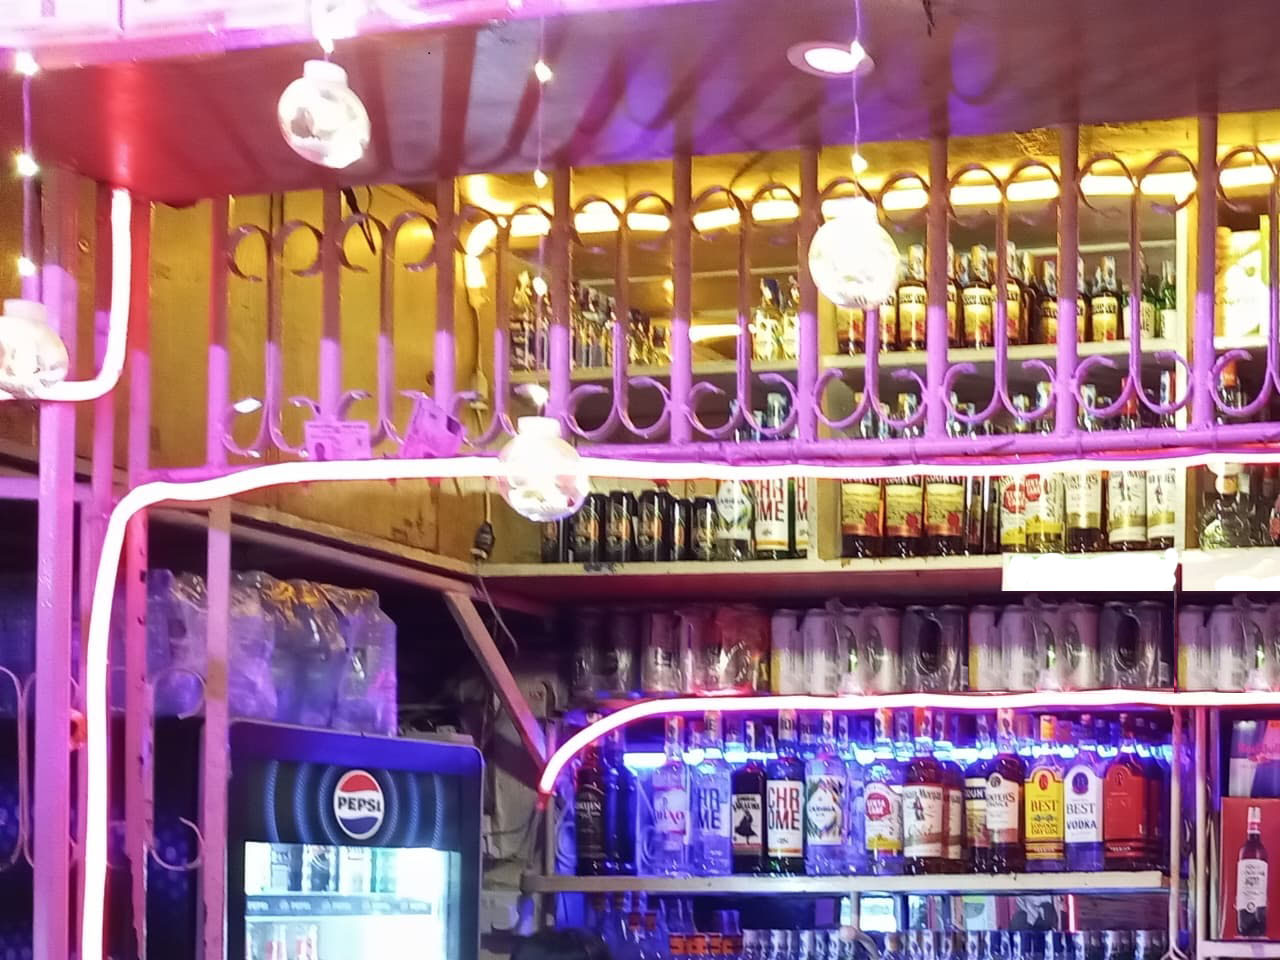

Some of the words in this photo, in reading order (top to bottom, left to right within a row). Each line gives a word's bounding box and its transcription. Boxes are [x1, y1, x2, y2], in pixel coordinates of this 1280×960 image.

[337, 796, 382, 812] PEPSI
[768, 787, 799, 809] CHR
[1031, 800, 1059, 812] BEST
[1066, 803, 1095, 815] BEST
[768, 810, 800, 831] OME
[1066, 819, 1098, 830] VODKA
